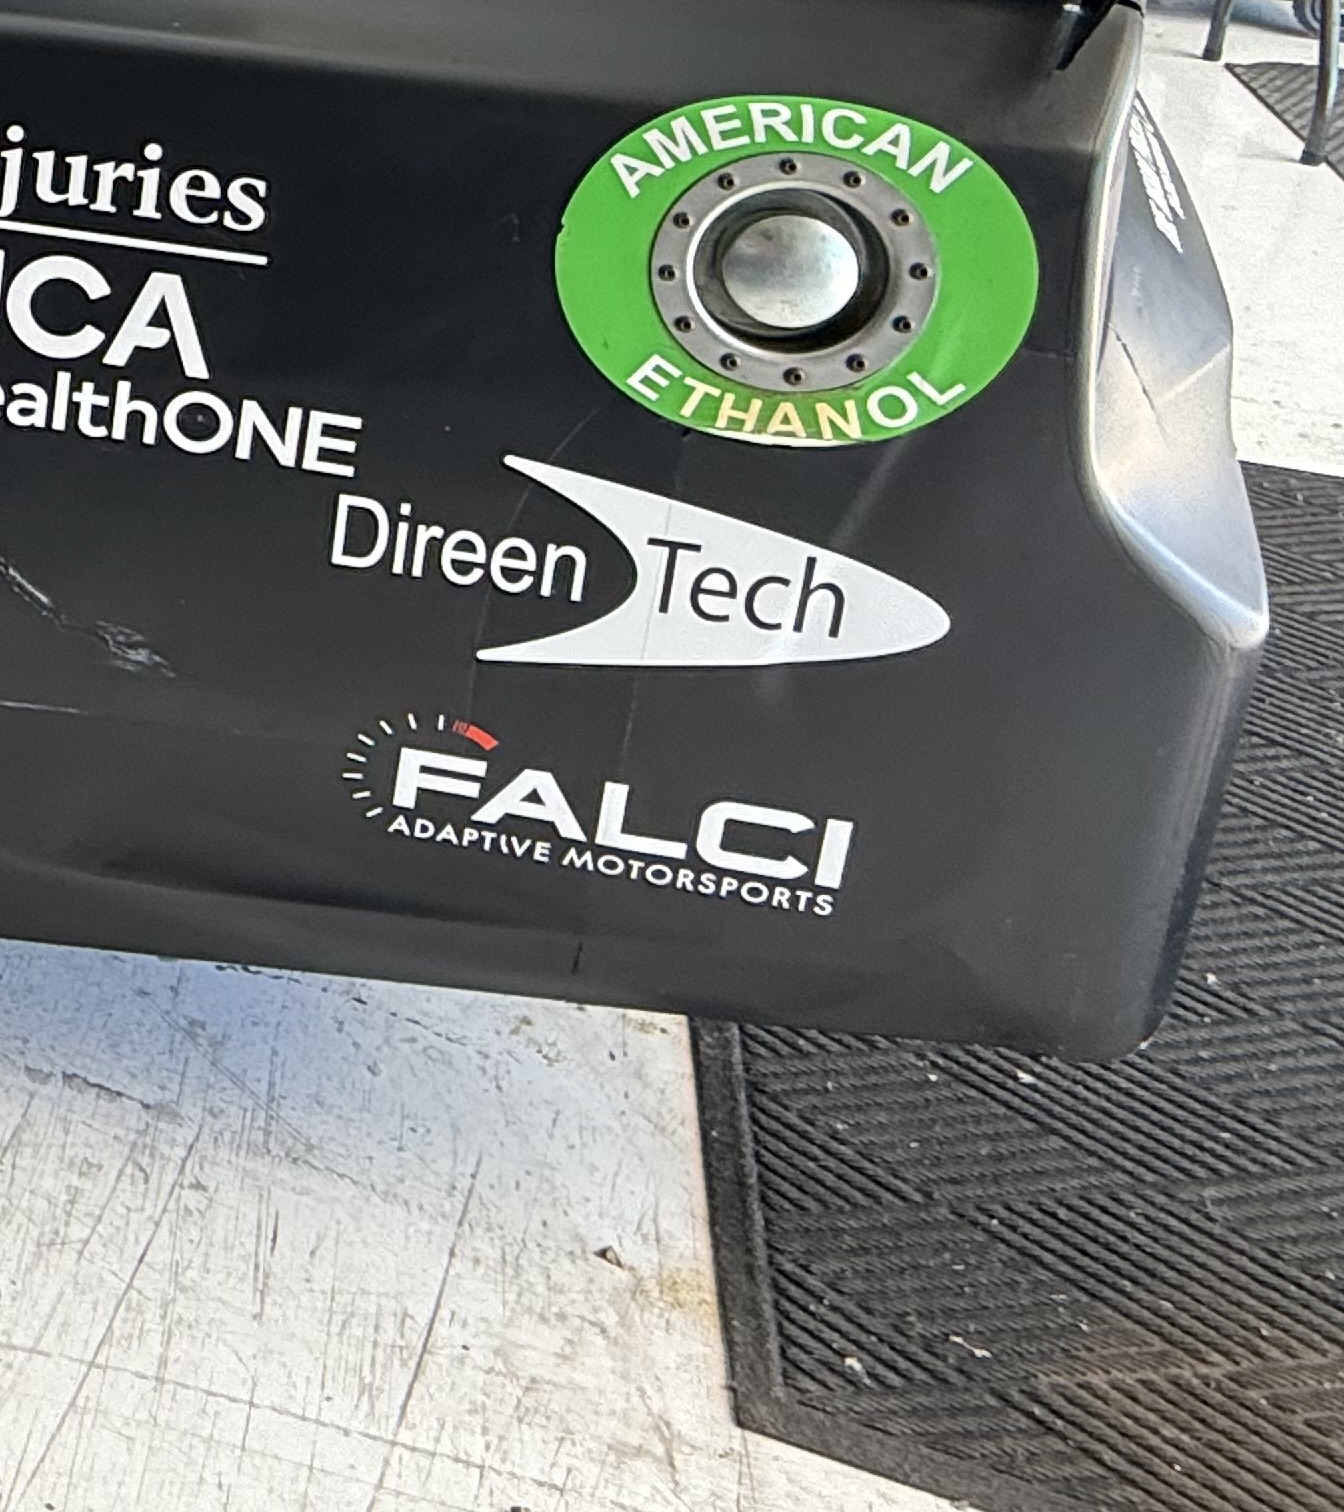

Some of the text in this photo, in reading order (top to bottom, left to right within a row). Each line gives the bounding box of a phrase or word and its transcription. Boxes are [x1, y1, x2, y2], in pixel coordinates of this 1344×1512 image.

[611, 101, 974, 198] AMERICAN
[626, 354, 966, 441] ETHANOL
[330, 493, 847, 638] Direen Tech
[387, 813, 835, 917] ADAPTIVE MOTORSPORTS
[392, 746, 854, 889] FALCI
